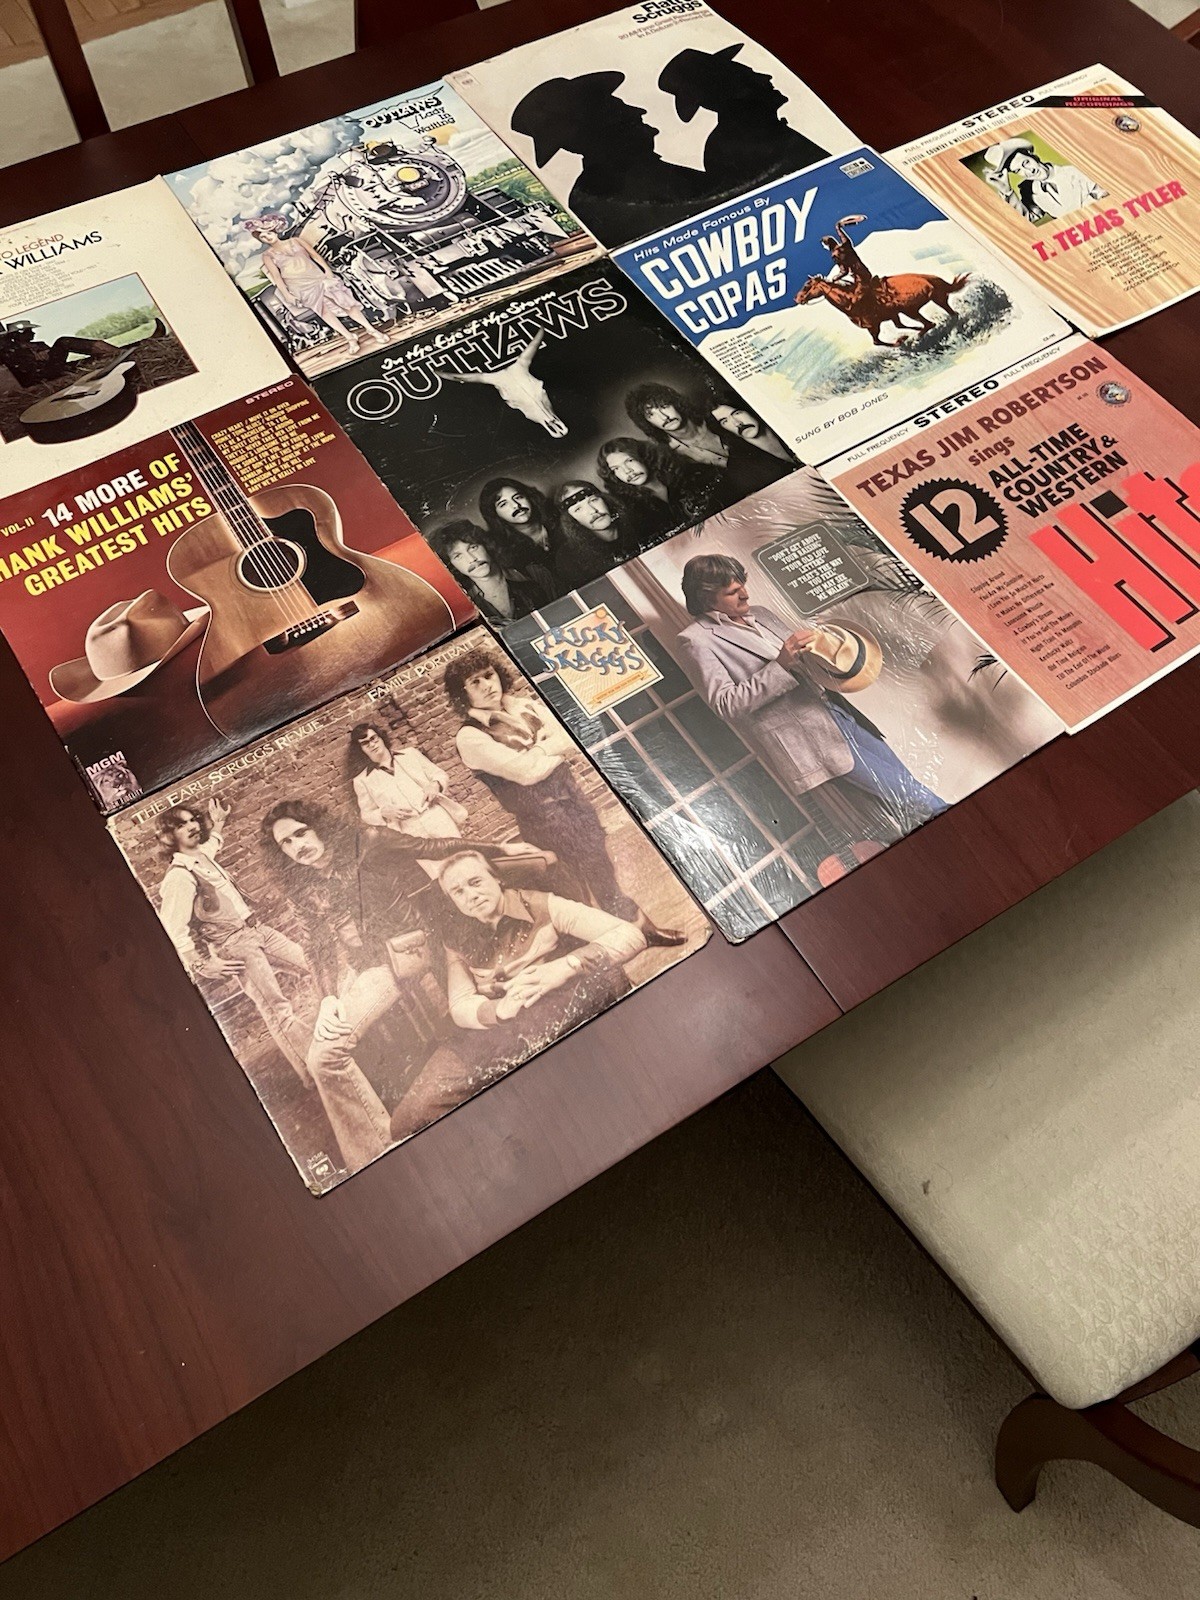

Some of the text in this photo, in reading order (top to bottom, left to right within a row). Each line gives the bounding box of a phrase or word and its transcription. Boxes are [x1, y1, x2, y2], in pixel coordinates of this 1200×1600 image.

[632, 0, 702, 23] Scruggs
[365, 96, 442, 128] OUTLAWS
[414, 117, 456, 134] Waiting
[419, 106, 445, 119] Lady
[962, 95, 1035, 129] STEREO
[926, 142, 948, 155] COUNTRY
[951, 131, 974, 144] WESTERN
[633, 197, 770, 262] Hits Made Famous By
[1031, 241, 1057, 262] T.
[1052, 208, 1125, 252] TEXAS
[1122, 179, 1188, 219] TYLER
[0, 233, 64, 260] O LEGEND
[4, 231, 103, 270] WILLIAMS
[640, 186, 818, 300] COWBOY
[674, 257, 787, 334] COPAS
[381, 291, 557, 370] In the Eye of the Storm
[347, 277, 628, 421] OUTLAWS
[245, 380, 294, 405] STEREO
[847, 346, 1062, 463] FULL FREQUENCY STEREO FULL FREQUENCY
[210, 429, 228, 440] CRAZY
[227, 422, 244, 432] HEART
[248, 413, 263, 423] MOVE
[277, 401, 290, 410] OVER
[795, 392, 889, 444] SUNG BY BOB JONES
[856, 449, 936, 499] TEXAS
[938, 424, 980, 459] JIM
[976, 356, 1108, 435] ROBERTSON
[968, 435, 1016, 467] sings
[988, 422, 1091, 490] ALL-TIME
[248, 483, 263, 494] BABY
[278, 466, 296, 479] REALLY
[302, 457, 316, 467] LOVE
[249, 471, 272, 485] MANSION
[1003, 434, 1119, 503] COUNTRY &
[1016, 450, 1129, 519] WESTERN
[1, 526, 25, 537] VOL.
[42, 503, 73, 528] 14
[74, 468, 149, 514] MORE
[149, 452, 181, 479] OF
[0, 472, 193, 583] HANK WILLIAMS'
[909, 488, 1000, 556] 12
[24, 496, 212, 597] GREATEST HITS
[781, 552, 799, 565] YOUR
[789, 542, 802, 552] GET
[801, 532, 821, 546] ABOVE
[801, 554, 814, 564] OLD
[813, 546, 829, 558] LOVE
[1028, 461, 1200, 653] Hit
[797, 569, 819, 584] THAT'S
[818, 563, 832, 573] THE
[829, 557, 843, 568] WAY
[808, 576, 822, 587] YOU
[822, 579, 836, 589] MAY
[834, 573, 847, 583] SEE
[970, 571, 1006, 594] Slipping Around
[817, 592, 828, 601] ME
[979, 594, 990, 602] You
[1003, 573, 1025, 587] Sunshine
[1000, 594, 1010, 602] You
[1014, 583, 1029, 593] Much
[1031, 573, 1046, 584] Hurts
[1017, 618, 1041, 634] Cowboy's
[1038, 610, 1054, 620] Dream
[1049, 619, 1059, 627] The
[1057, 611, 1075, 623] Money
[542, 621, 626, 655] RICKY
[1038, 647, 1062, 662] Kentucky
[366, 640, 477, 702] FAMILY PORTRAIT
[540, 645, 645, 676] SKAGGS
[1064, 667, 1075, 675] The
[1072, 661, 1084, 670] End
[1087, 652, 1098, 660] The
[1064, 674, 1090, 690] Columbus
[1107, 652, 1122, 662] Blues
[85, 750, 126, 776] MGM
[131, 802, 166, 824] THE
[167, 780, 208, 805] EARL
[208, 745, 275, 790] SCRUGGS
[275, 718, 325, 750] REVUE
